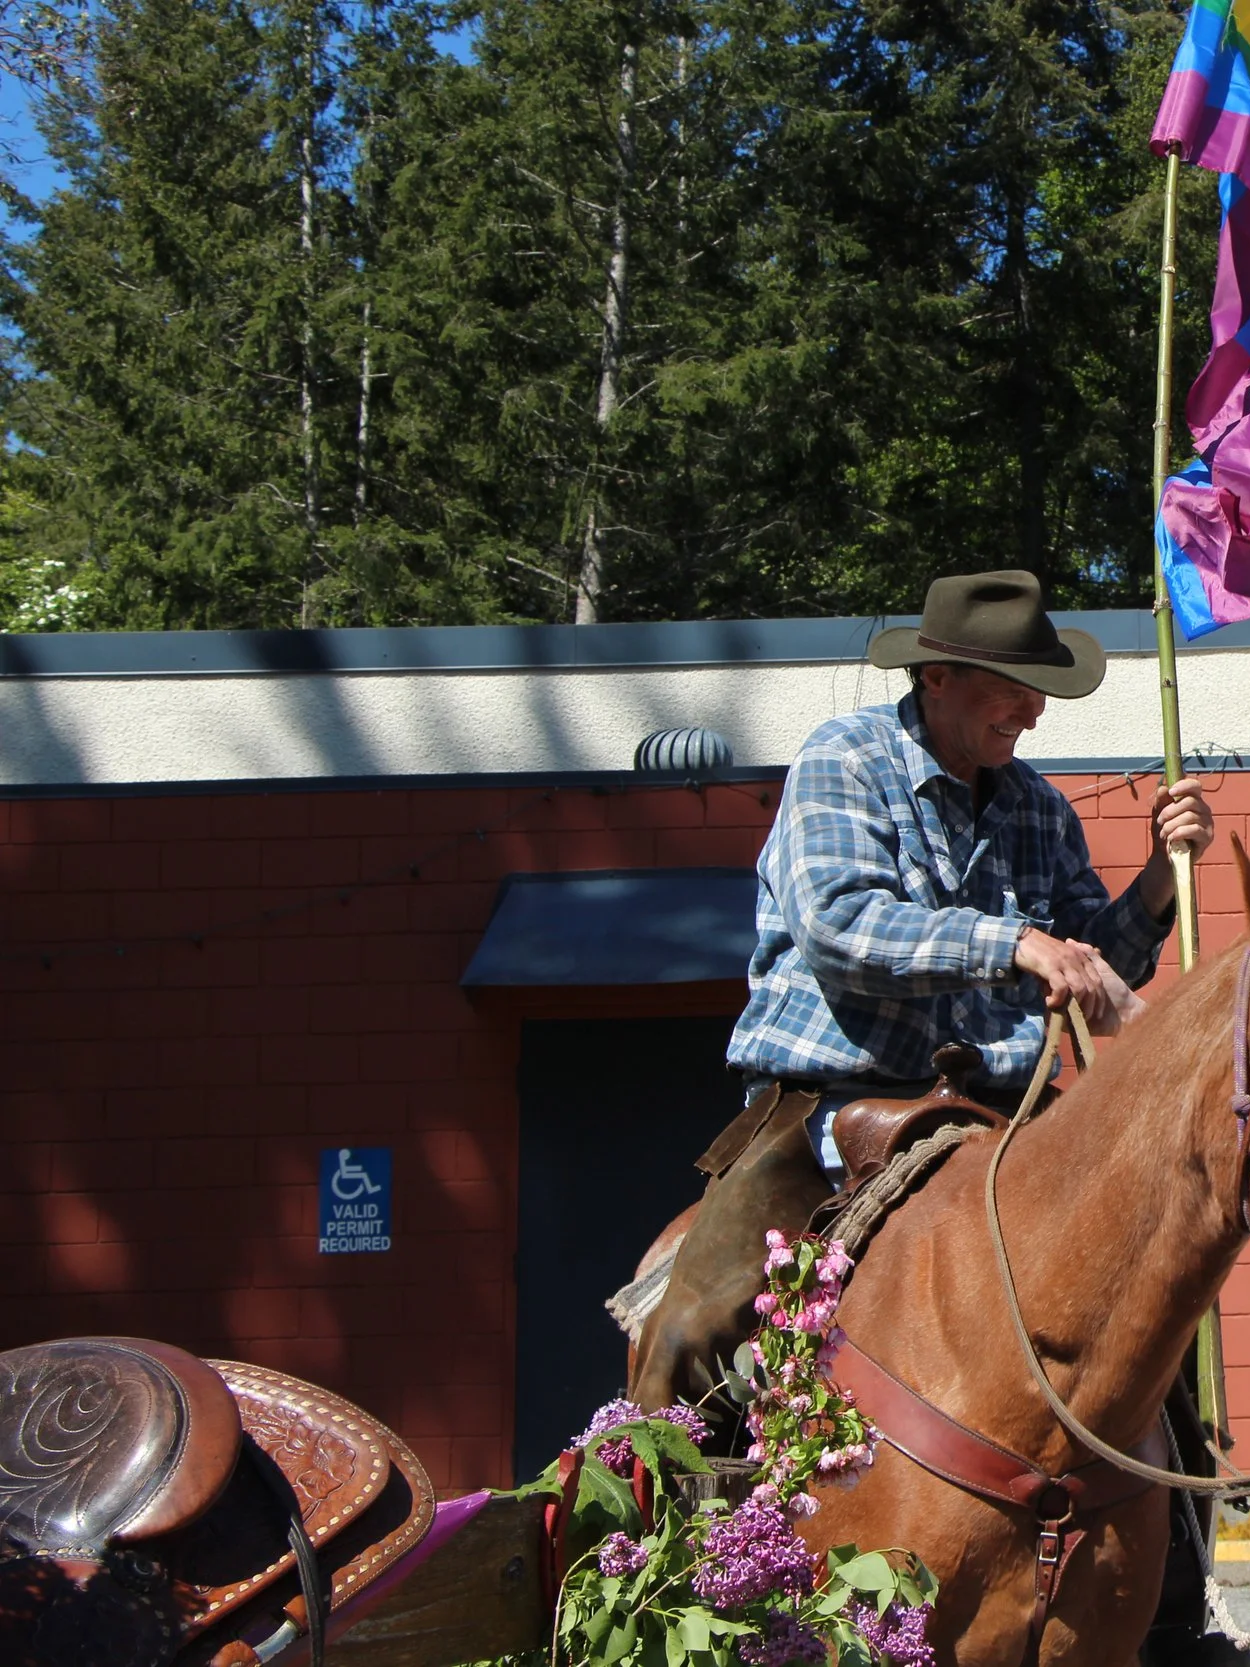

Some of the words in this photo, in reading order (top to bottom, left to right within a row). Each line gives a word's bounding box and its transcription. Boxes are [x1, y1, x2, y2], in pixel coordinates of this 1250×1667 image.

[333, 1203, 379, 1219] VALID
[326, 1220, 383, 1236] PERMIT
[319, 1236, 392, 1253] REQUIRED
